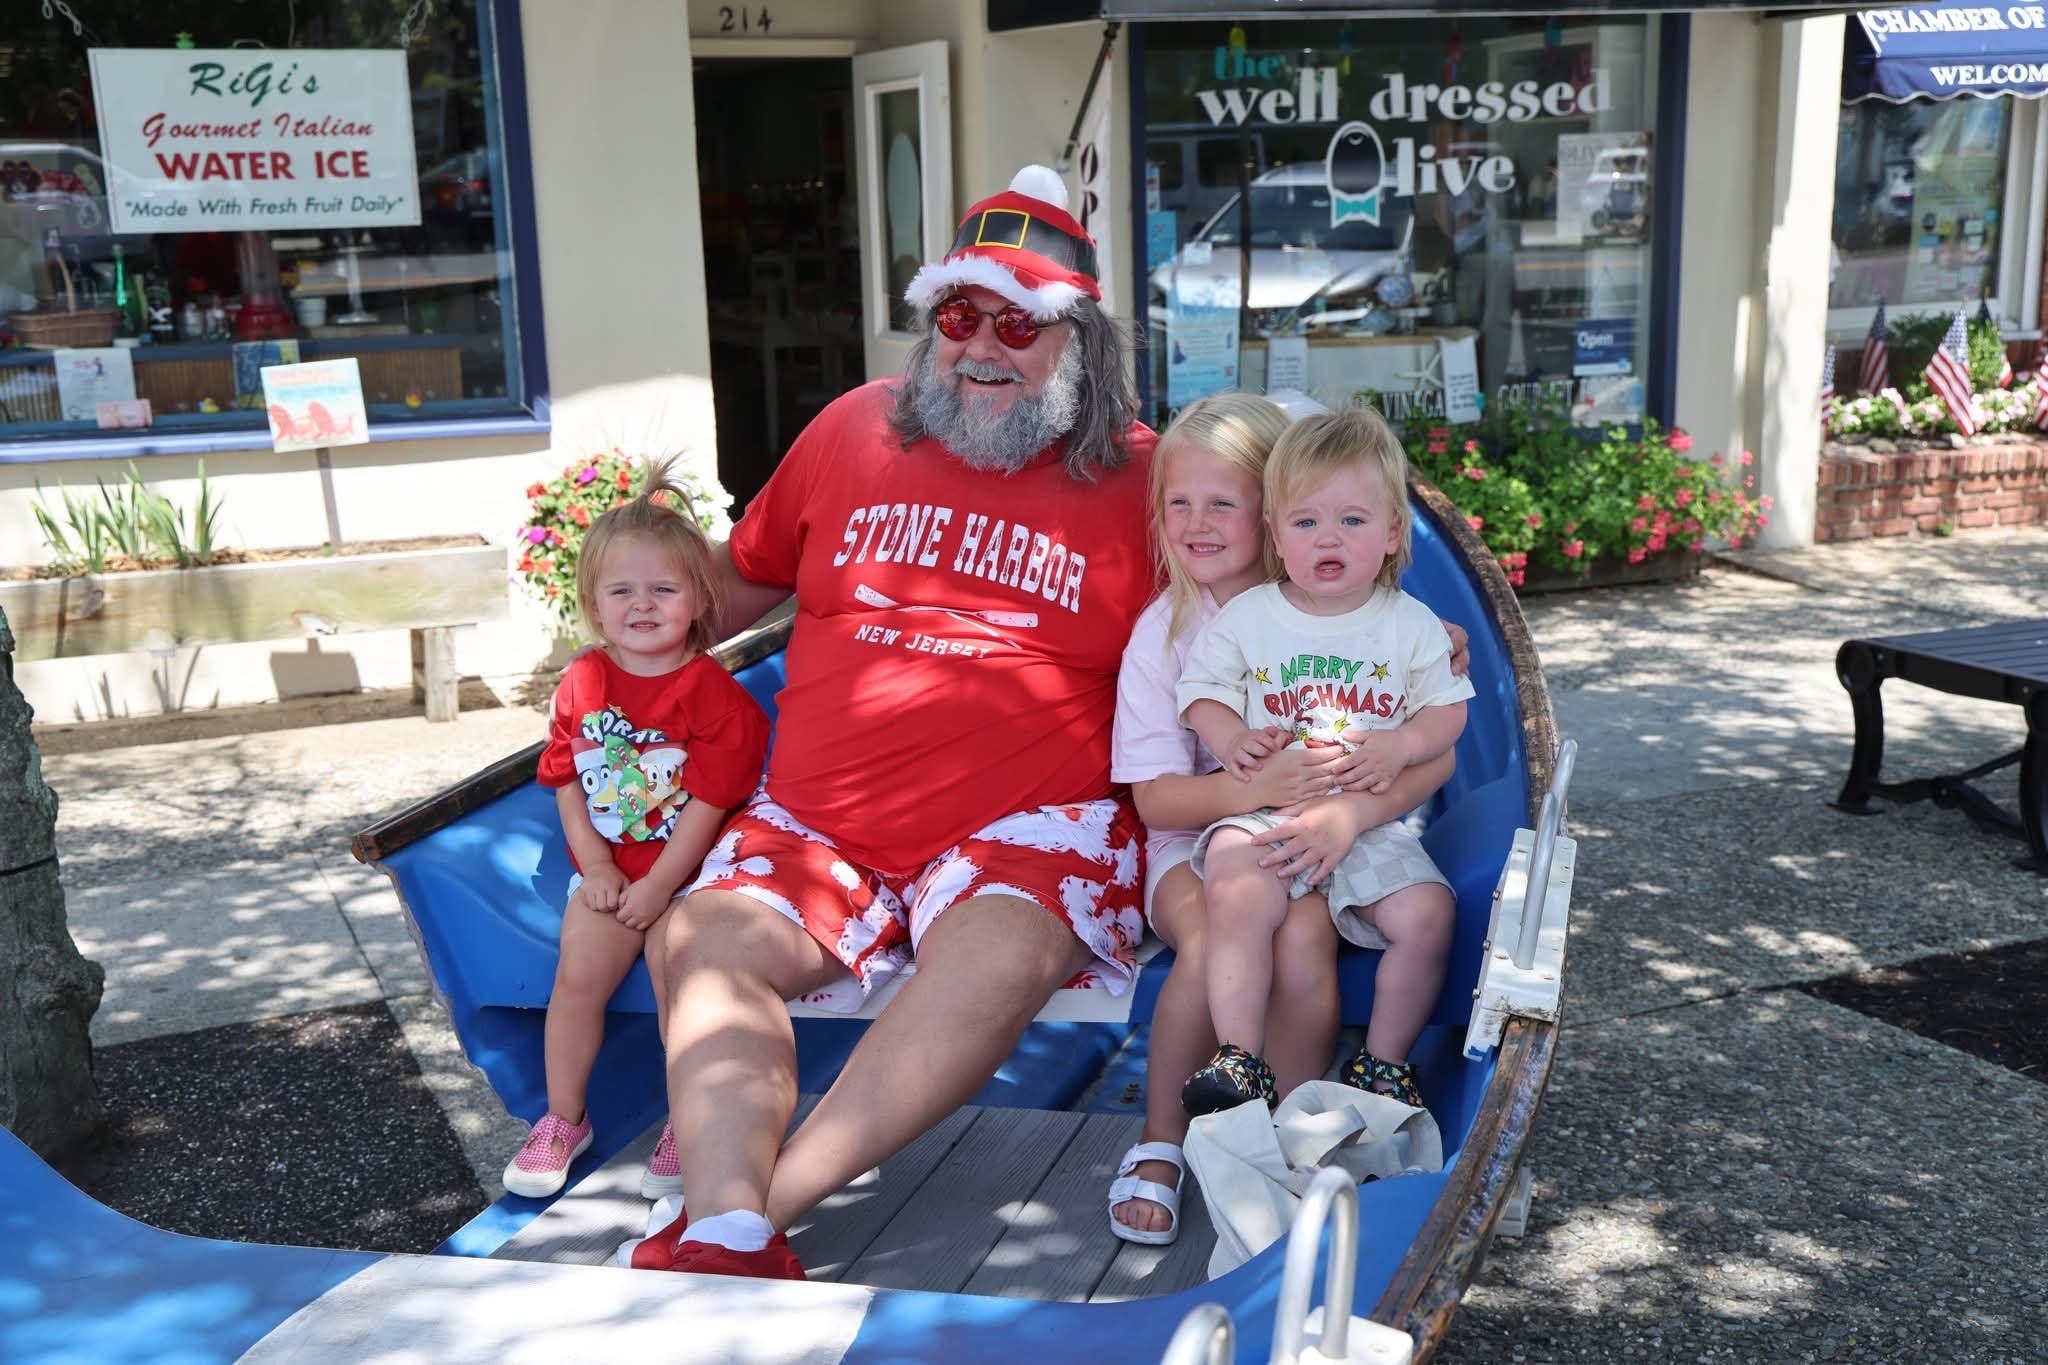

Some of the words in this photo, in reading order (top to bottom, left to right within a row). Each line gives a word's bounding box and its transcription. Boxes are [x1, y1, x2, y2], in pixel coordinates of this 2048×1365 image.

[718, 6, 773, 32] 214
[1865, 9, 2008, 33] CHAMBER
[2008, 7, 2046, 29] OF
[1214, 46, 1281, 79] the
[189, 62, 320, 107] RiGi's
[1196, 67, 1339, 126] well
[1370, 68, 1615, 124] dressed
[142, 112, 262, 148] Gourmet
[274, 112, 373, 138] Italian
[155, 151, 295, 181] WATER
[315, 150, 370, 179] ICE
[125, 201, 188, 217] "Made
[199, 198, 242, 215] With
[251, 197, 297, 215] Fresh
[305, 196, 344, 214] Fruit
[351, 195, 404, 216] Daily"
[1577, 331, 1614, 350] Open
[833, 503, 952, 567] STONE
[953, 513, 1086, 614] HARBOR
[854, 624, 901, 645] NEW
[1281, 655, 1364, 687] MERRY
